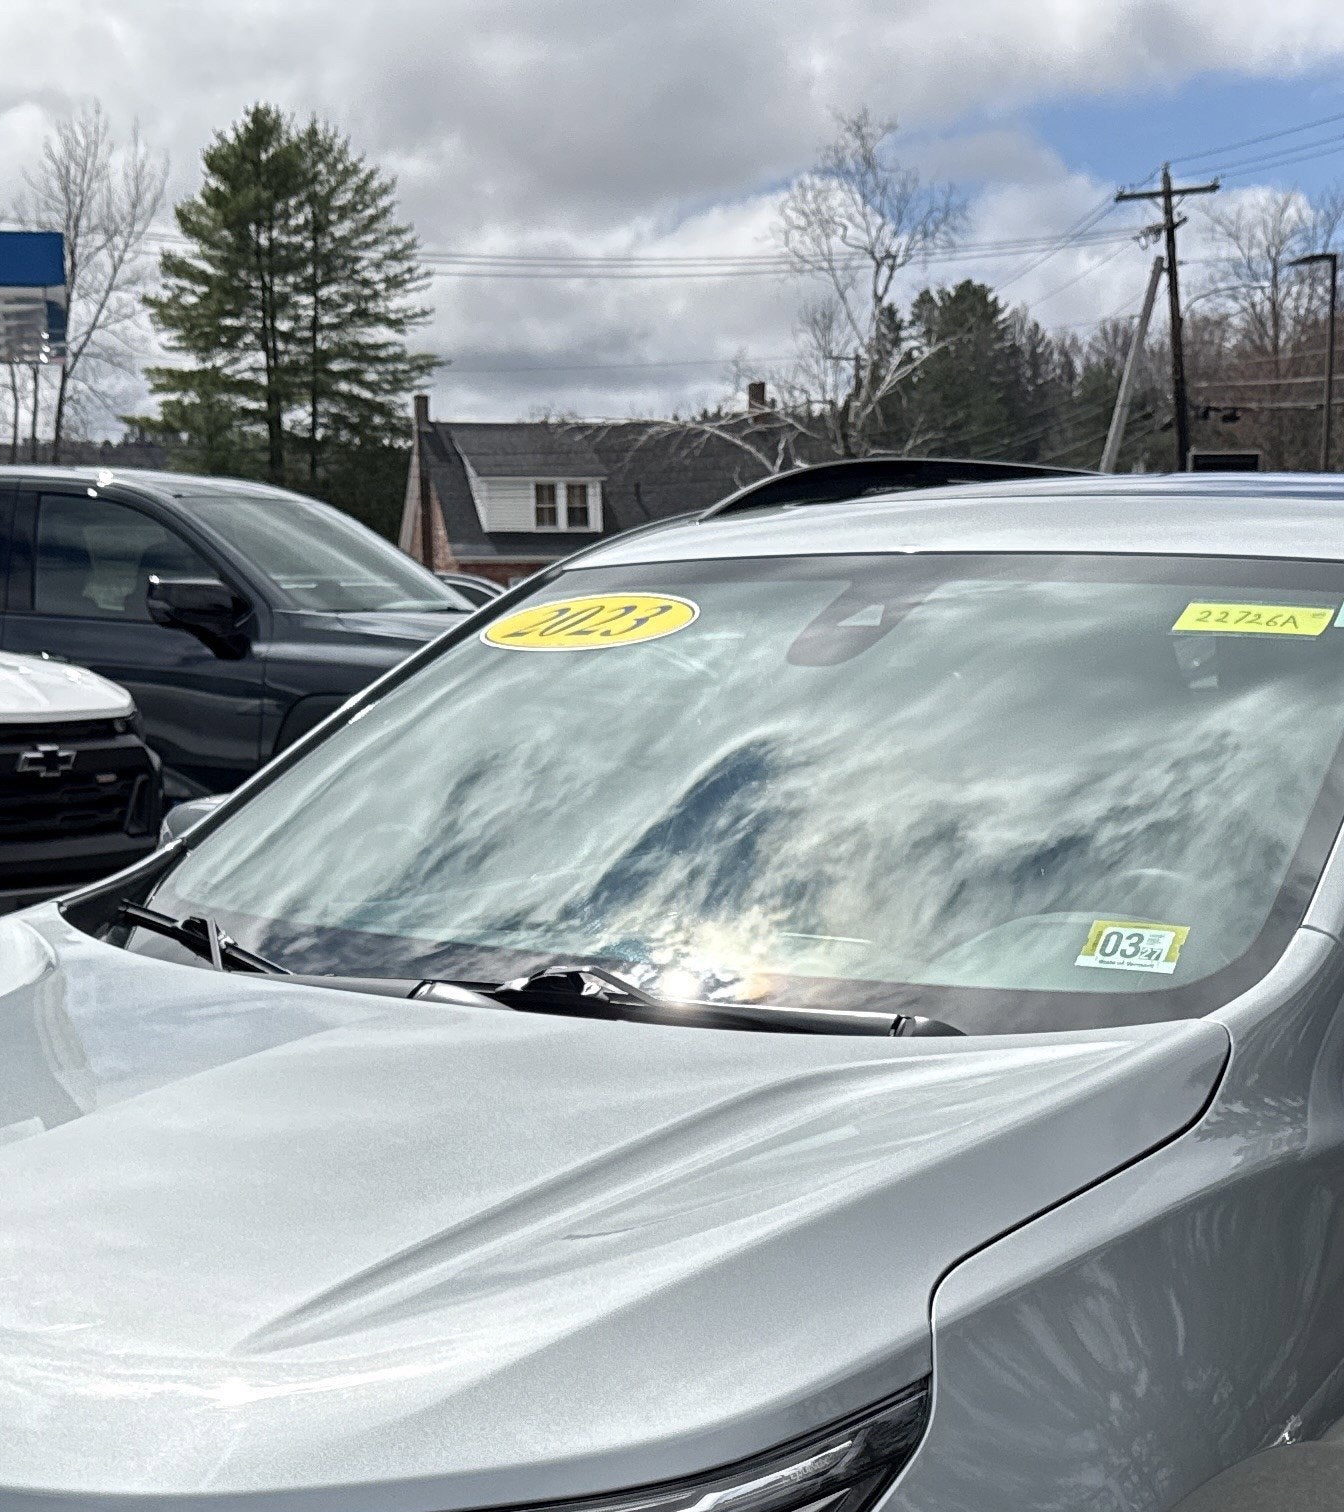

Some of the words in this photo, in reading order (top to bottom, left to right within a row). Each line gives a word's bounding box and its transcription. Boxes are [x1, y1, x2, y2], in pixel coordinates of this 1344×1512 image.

[501, 605, 673, 638] 2023
[1196, 610, 1299, 630] 22726A
[1099, 931, 1144, 958] 03
